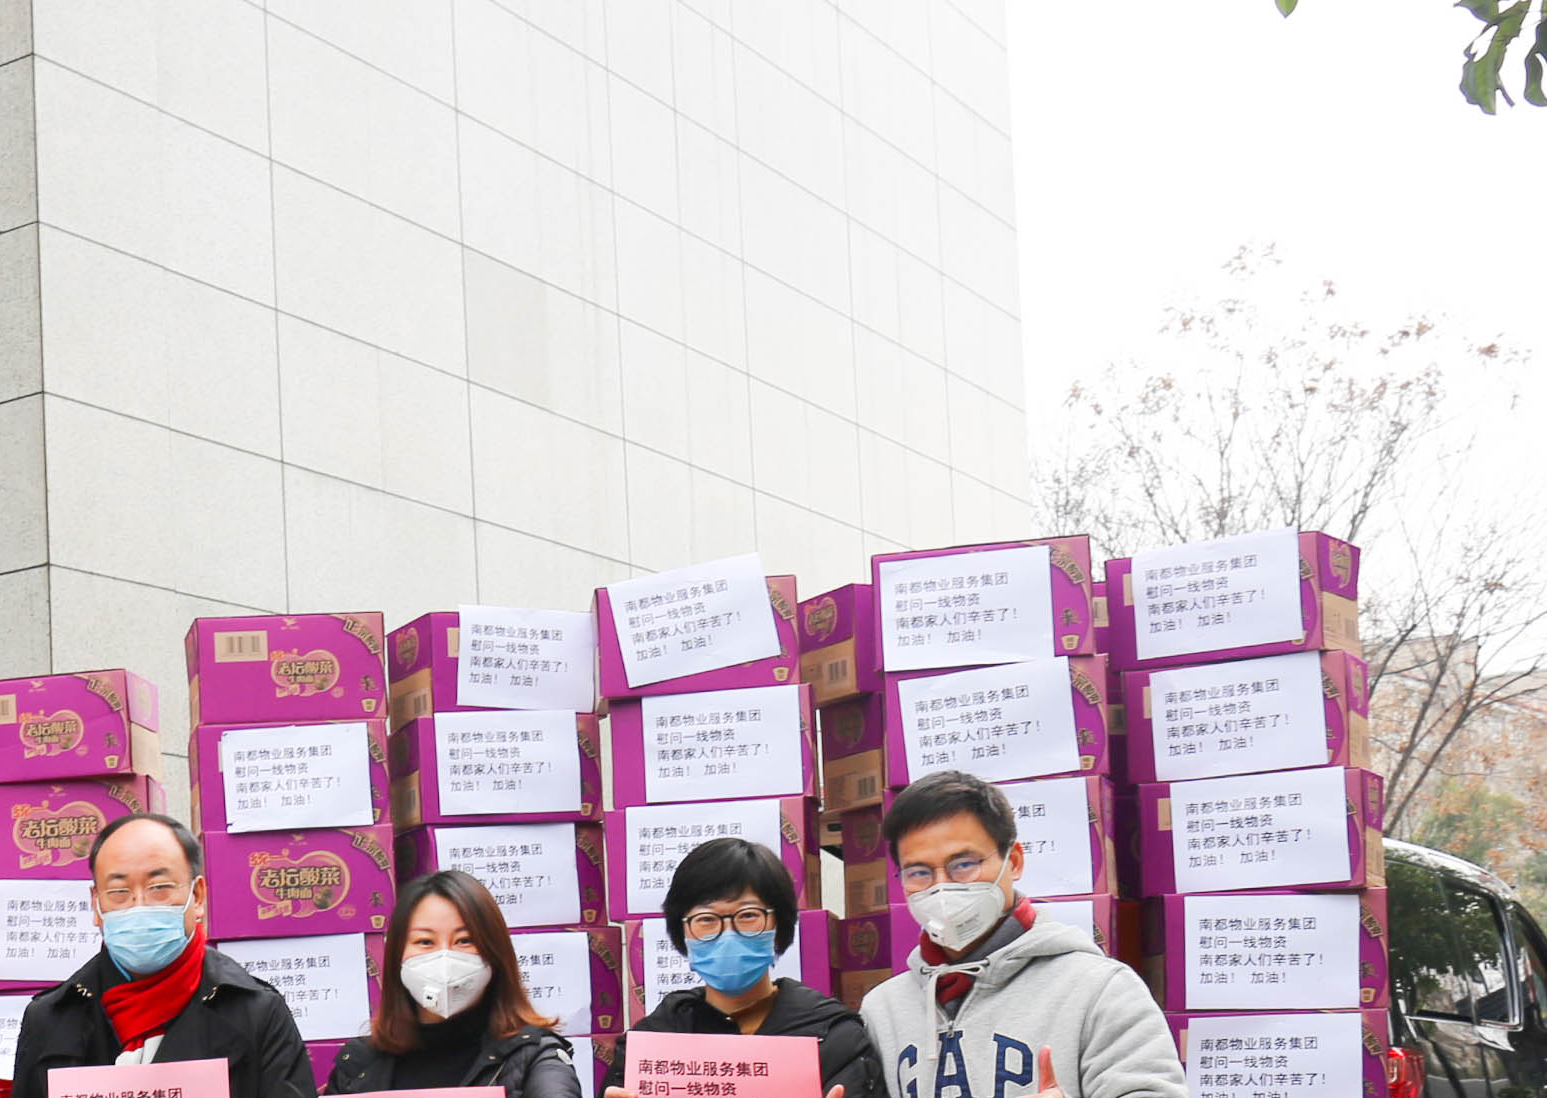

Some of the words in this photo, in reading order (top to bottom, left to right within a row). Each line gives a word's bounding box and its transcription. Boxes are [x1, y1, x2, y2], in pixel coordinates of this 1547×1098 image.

[656, 709, 761, 728] 南都物业服务集团
[26, 719, 77, 738] 老坛酸菜
[448, 728, 543, 744] 南都物业服务集团
[657, 728, 735, 747] 慰问一线物资
[449, 746, 520, 760] 慰问一线物资
[657, 744, 768, 762] 南都家人们辛苦了！
[449, 760, 551, 777] 南都家人们辛苦了！
[658, 765, 689, 778] 加油！
[704, 762, 736, 775] 加油！
[451, 779, 480, 792] 加油！
[493, 777, 521, 791] 加油！
[20, 815, 98, 838] 老坛酸菜
[35, 836, 71, 851] 牛肉面
[260, 866, 341, 887] 老坛酸菜
[275, 886, 314, 900] 牛肉面
[1199, 917, 1316, 931] 南都物业服务集团
[1199, 935, 1287, 949] 慰问一线物资
[1200, 951, 1323, 967] 南都家人们辛苦了！
[1200, 971, 1234, 984] 加油！
[1251, 971, 1285, 984] 加油！
[639, 1059, 768, 1077] 南都物业服务集团
[639, 1080, 737, 1096] 慰问一线物资
